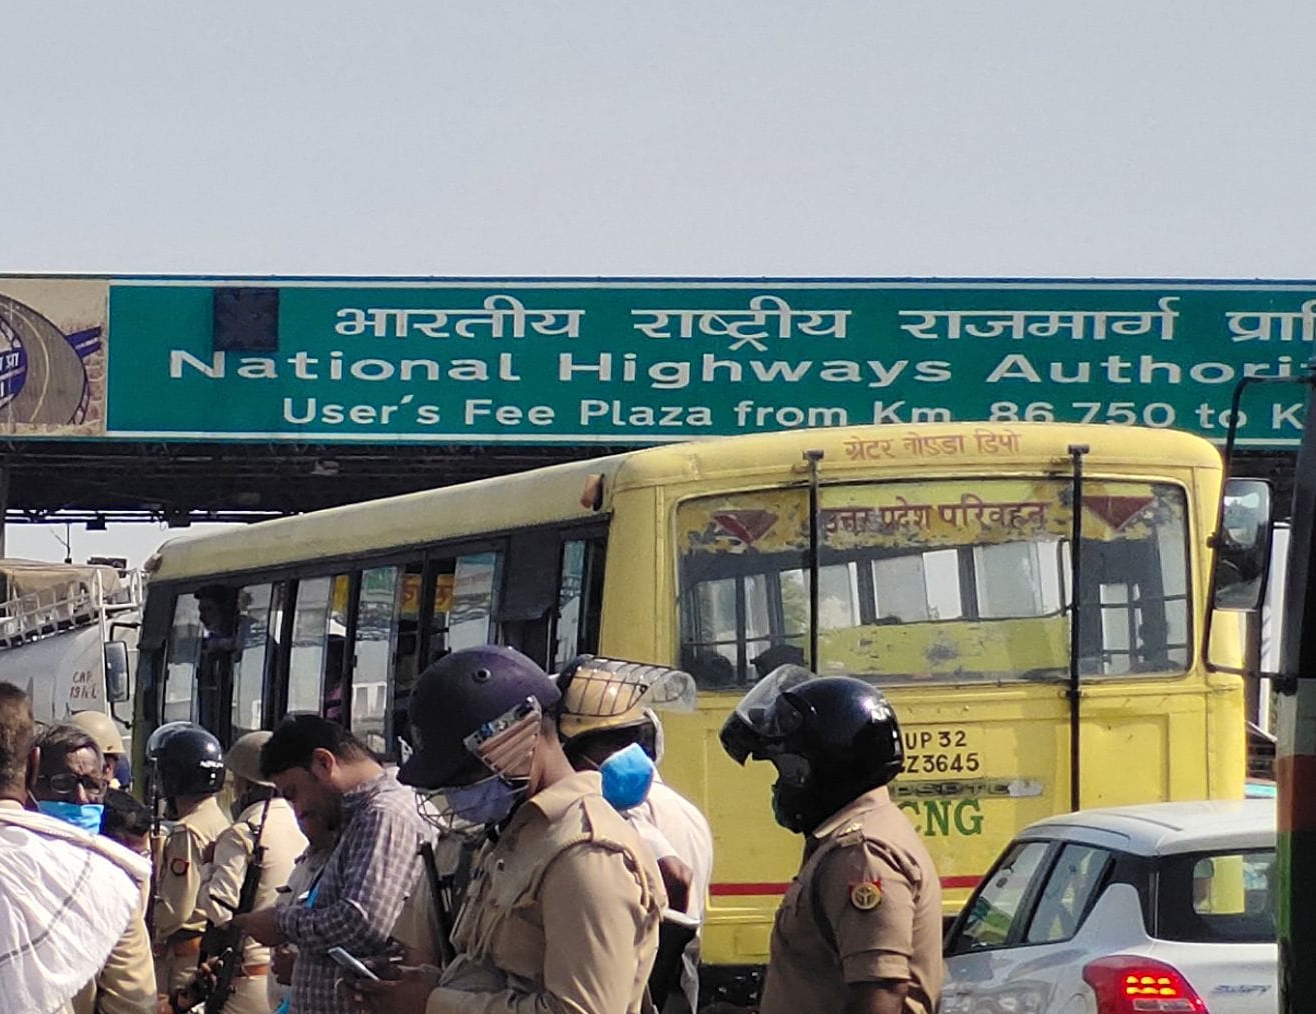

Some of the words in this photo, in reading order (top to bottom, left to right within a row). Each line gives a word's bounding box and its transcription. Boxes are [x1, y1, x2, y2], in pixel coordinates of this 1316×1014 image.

[335, 294, 585, 338] भारतीय
[631, 295, 851, 352] राष्ट्रीय
[898, 296, 1181, 340] राजमार्ग
[170, 350, 521, 380] National
[559, 353, 951, 388] Highways
[985, 354, 1309, 384] Authori
[283, 394, 441, 424] User's
[464, 399, 555, 426] Fee
[580, 399, 713, 426] Plaza
[733, 400, 847, 428] from
[873, 400, 951, 426] Km
[1195, 402, 1249, 430] to
[905, 731, 933, 750] UP
[938, 730, 967, 748] 32
[899, 752, 981, 774] Z3645
